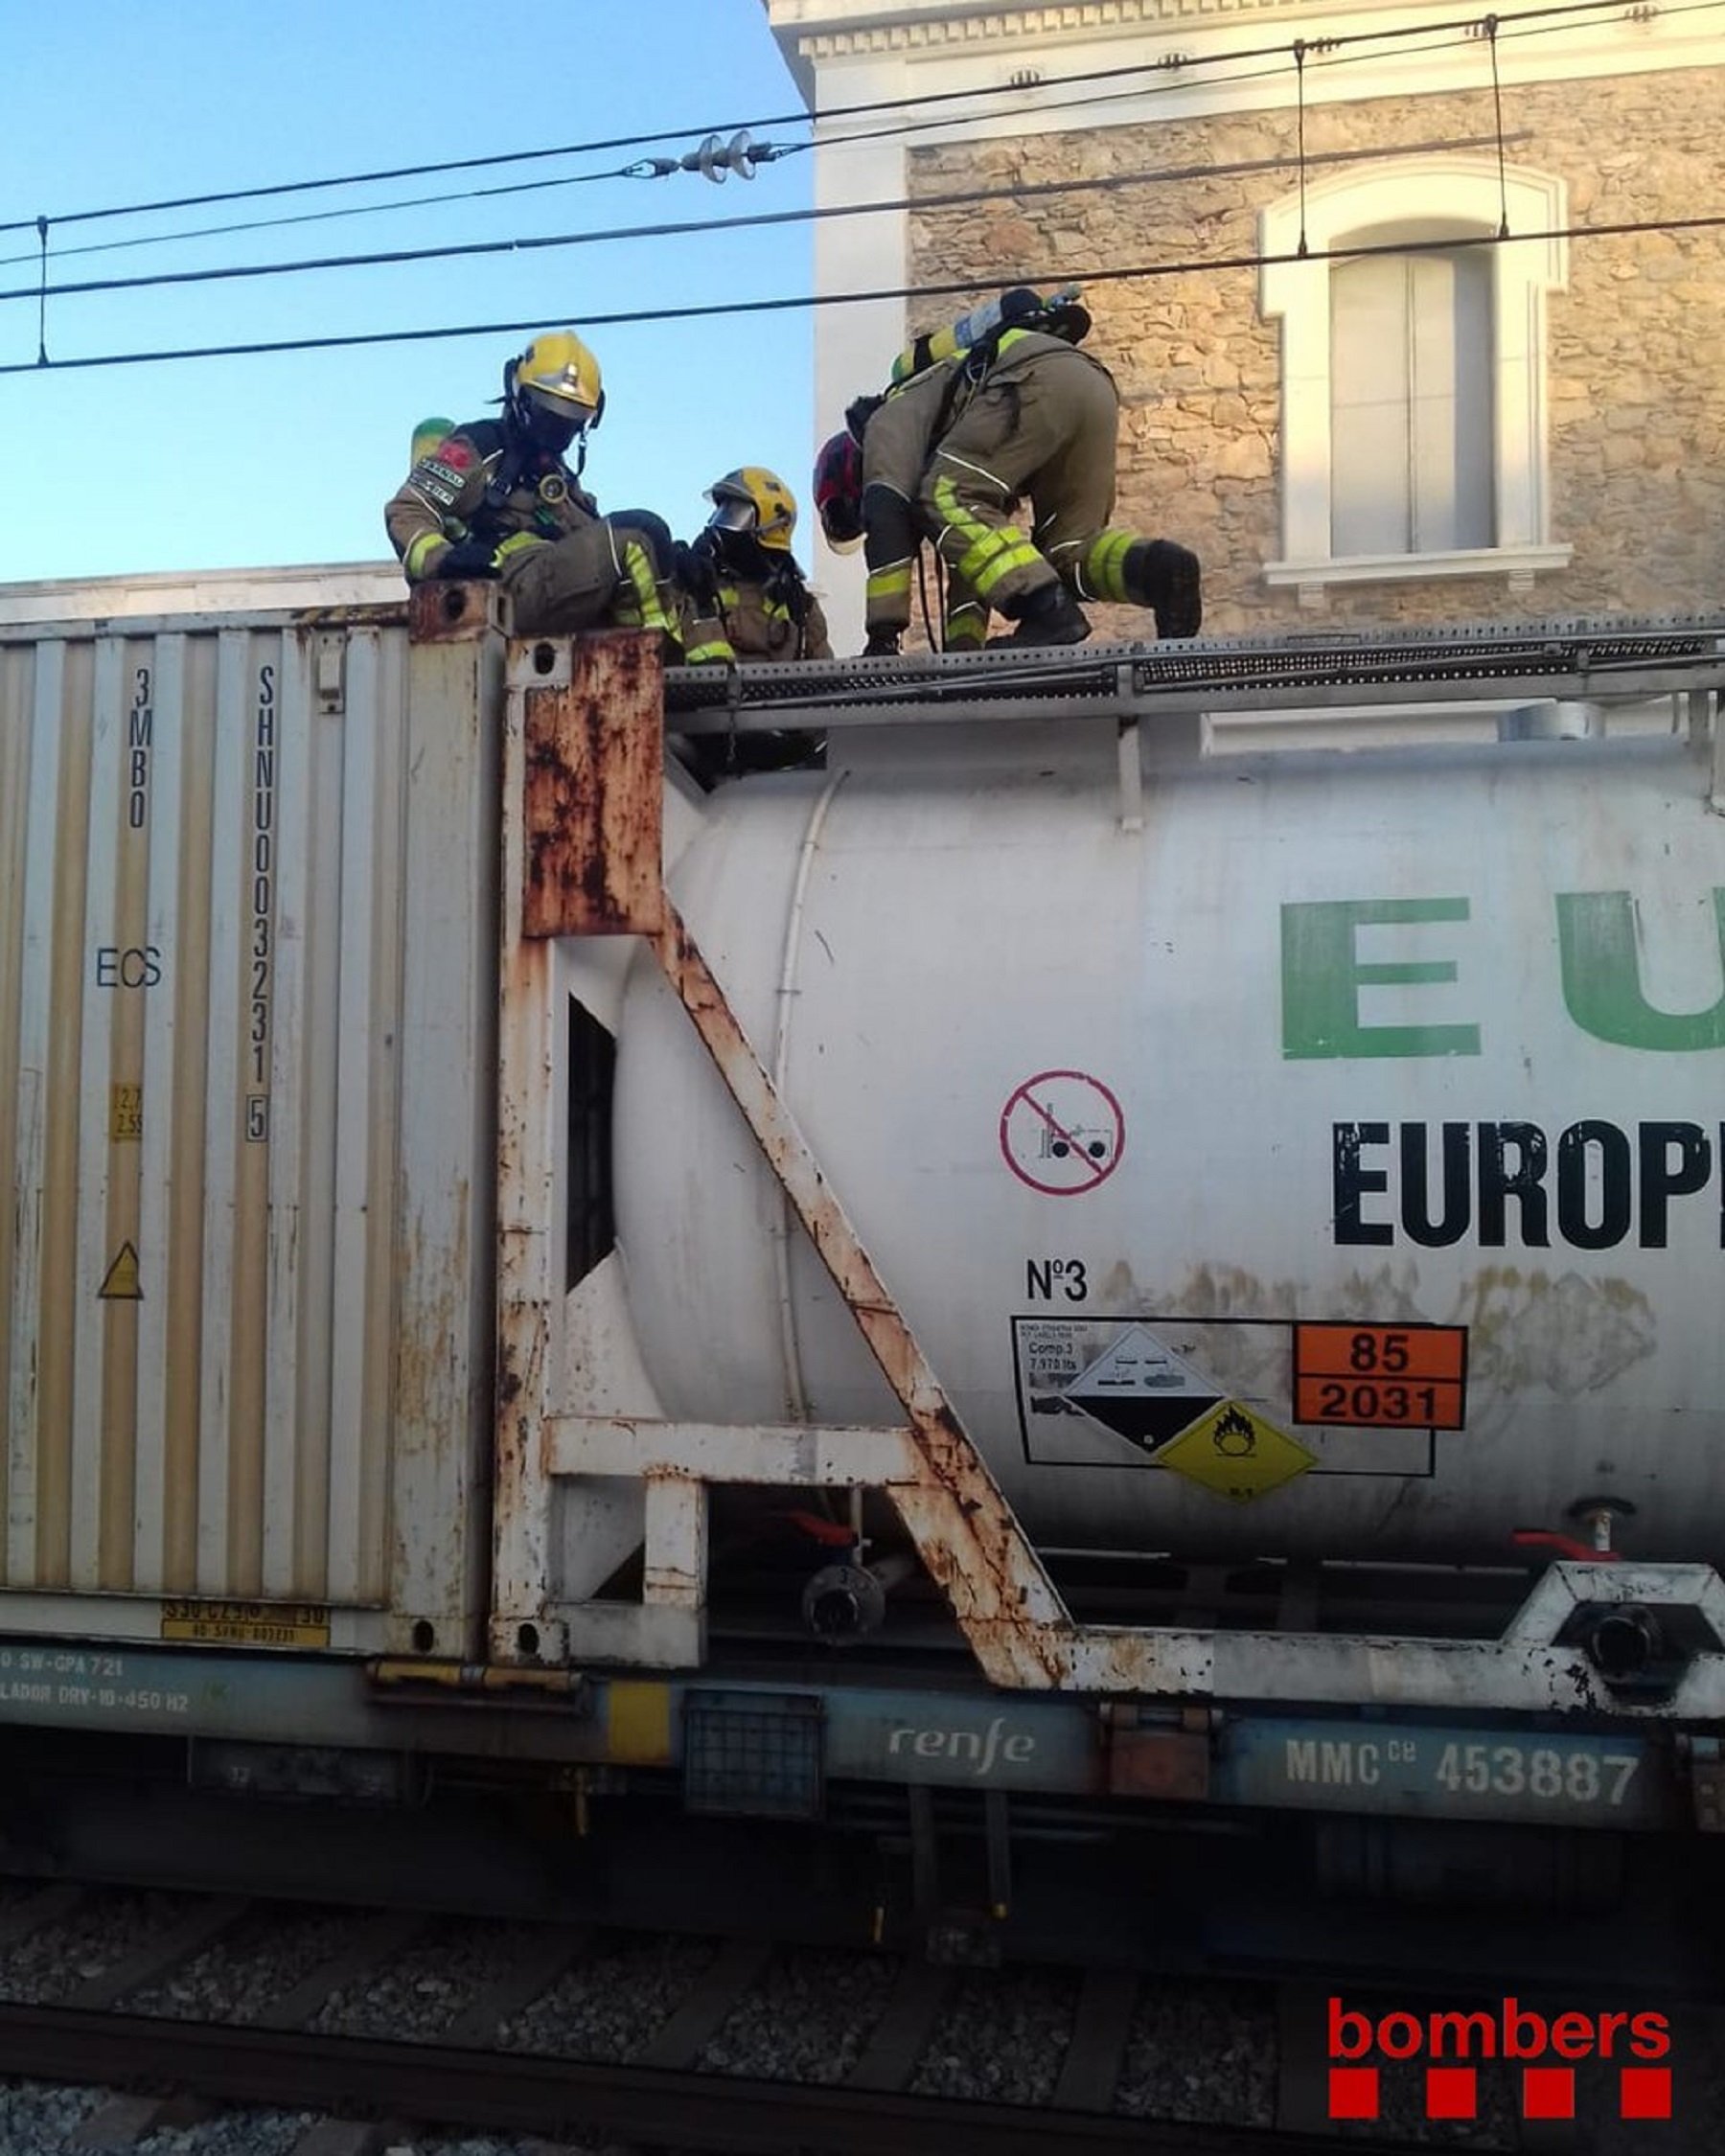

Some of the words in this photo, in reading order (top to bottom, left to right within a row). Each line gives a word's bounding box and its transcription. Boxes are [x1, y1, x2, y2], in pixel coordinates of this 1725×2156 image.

[96, 948, 162, 989] ECS
[250, 1099, 265, 1138] 5
[1332, 1118, 1725, 1249] EUROP
[1349, 1333, 1410, 1373] 85
[1320, 1384, 1438, 1420] 2031
[887, 1717, 1036, 1775] renfe
[1437, 1742, 1639, 1805] 453887
